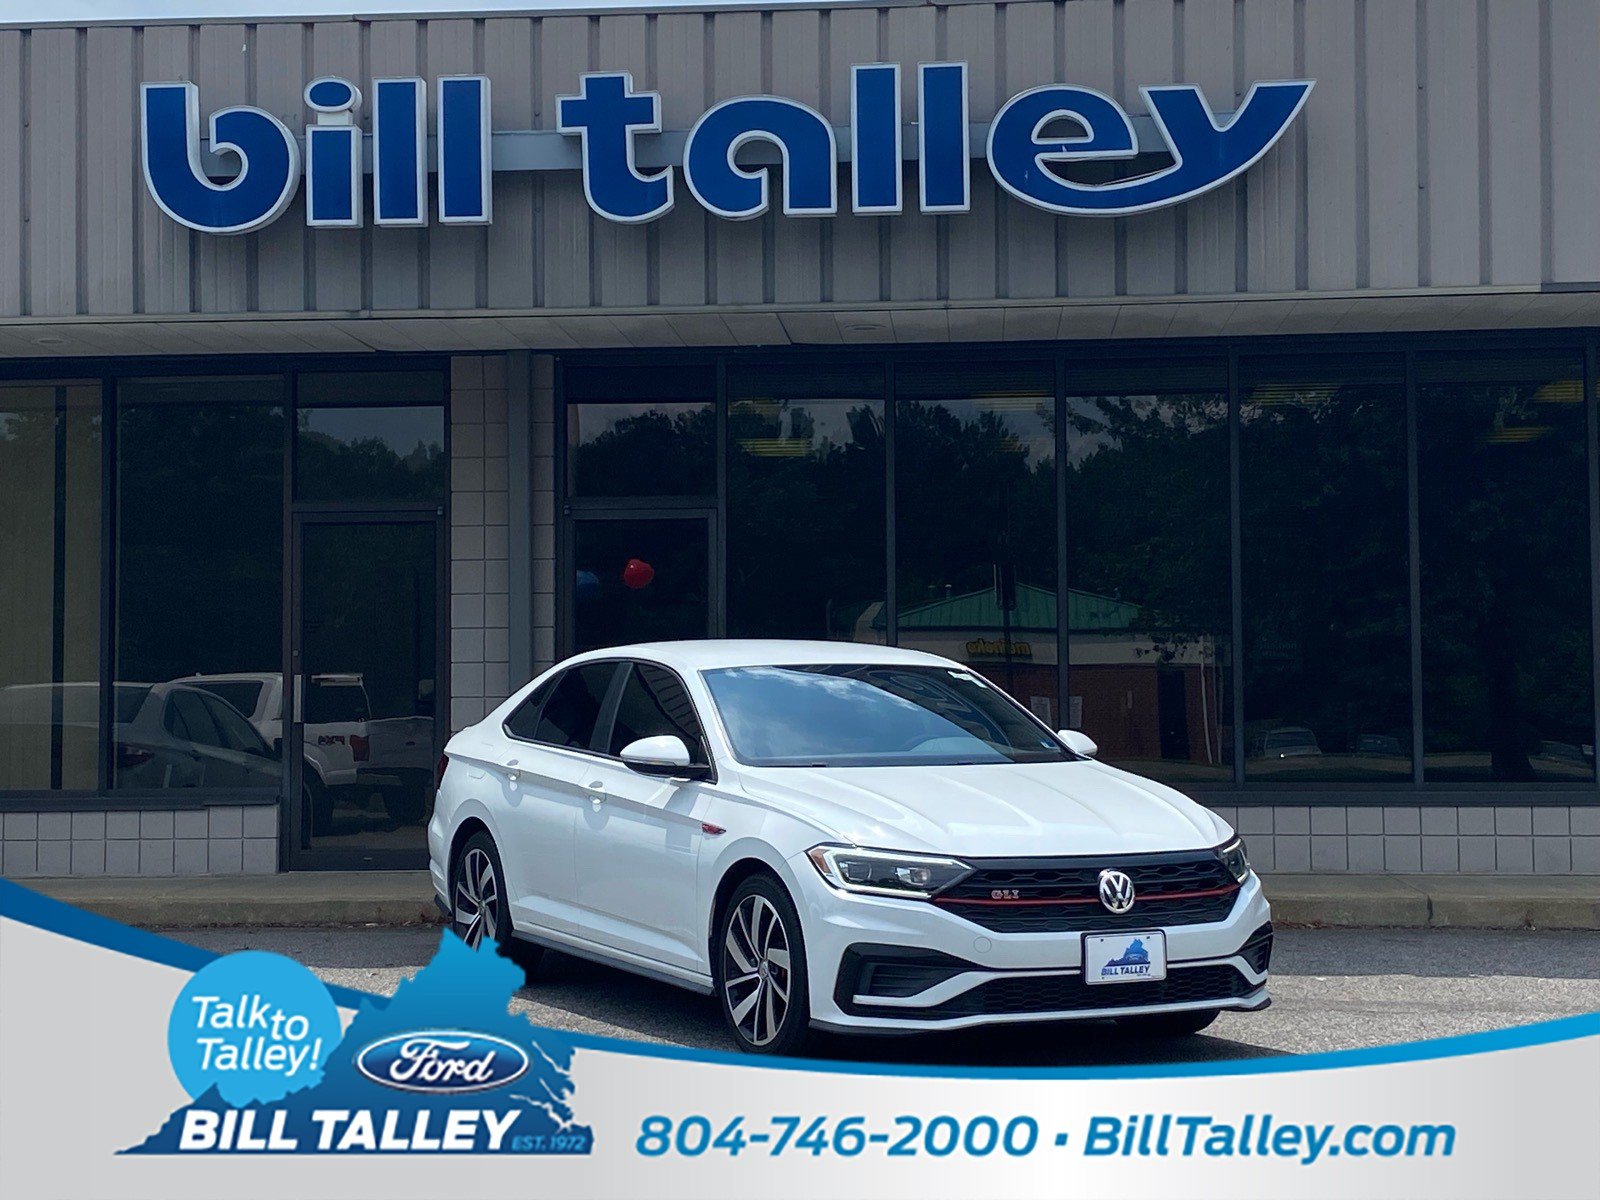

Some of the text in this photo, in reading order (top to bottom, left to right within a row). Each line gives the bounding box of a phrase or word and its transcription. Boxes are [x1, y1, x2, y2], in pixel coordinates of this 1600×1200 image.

[140, 61, 1317, 234] bill talley
[991, 889, 1020, 900] GLI
[1101, 965, 1150, 976] BILL TALLEY
